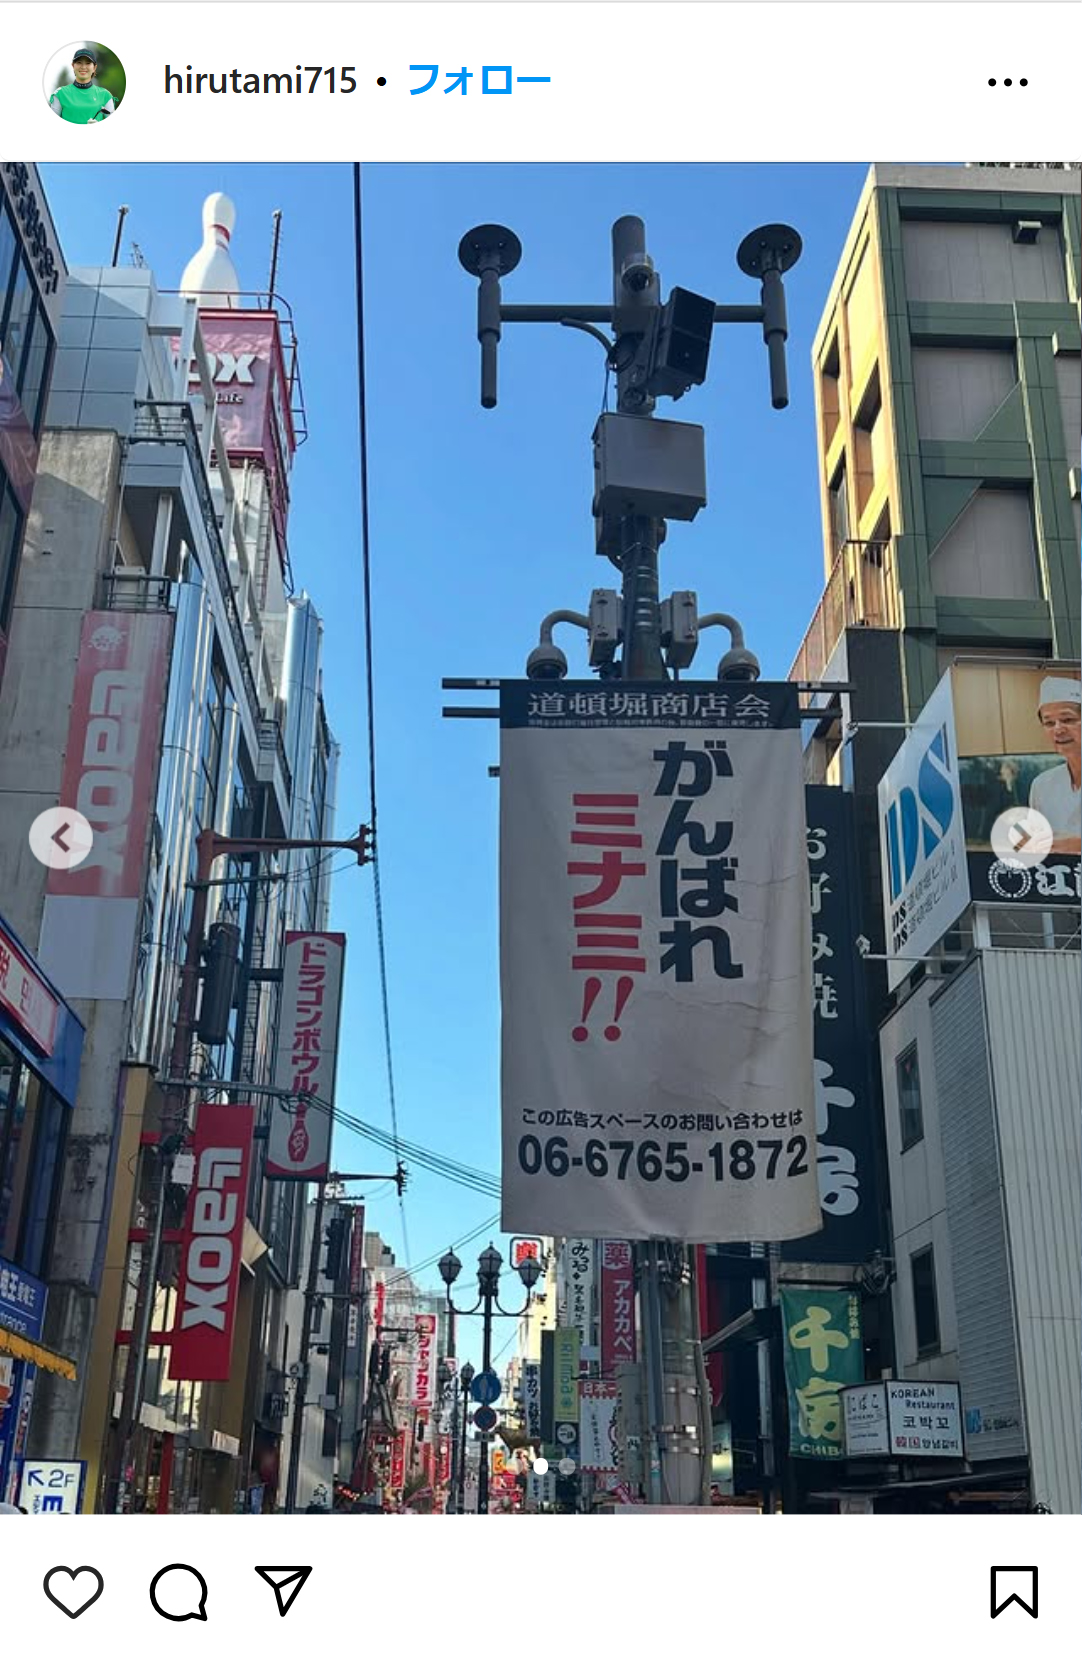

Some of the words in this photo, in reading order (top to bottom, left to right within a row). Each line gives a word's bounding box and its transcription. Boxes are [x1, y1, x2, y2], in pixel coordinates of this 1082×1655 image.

[528, 692, 771, 718] 道頓堀商店会
[886, 722, 955, 904] DS
[652, 740, 743, 982] がんばれ
[289, 942, 324, 1095] ドラゴンボウル
[522, 1108, 803, 1132] この広告スペースのお問い合わせは
[518, 1134, 809, 1182] 06-6765-1872
[613, 1280, 633, 1352] アカカベ
[891, 1387, 935, 1399] KOREAN
[905, 1399, 956, 1411] Restaurant
[800, 1443, 848, 1458] CHIB
[48, 1469, 75, 1488] 2F
